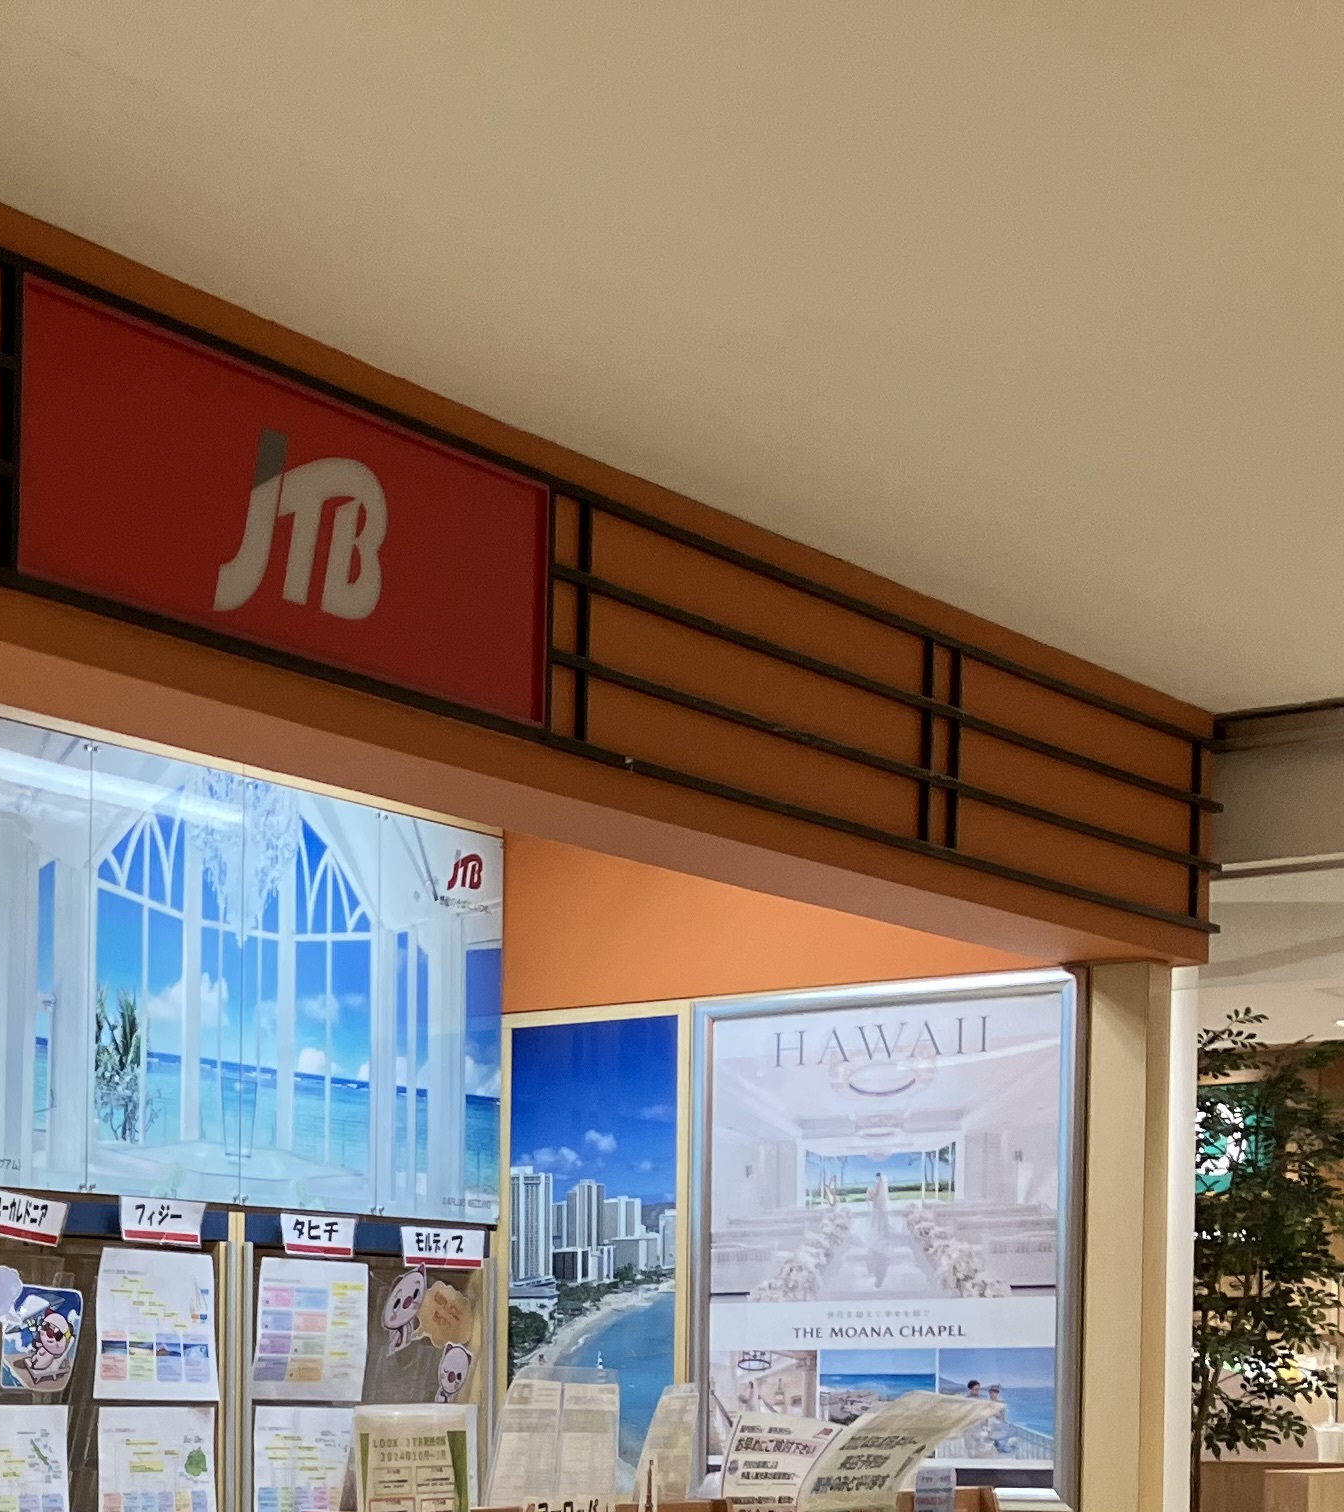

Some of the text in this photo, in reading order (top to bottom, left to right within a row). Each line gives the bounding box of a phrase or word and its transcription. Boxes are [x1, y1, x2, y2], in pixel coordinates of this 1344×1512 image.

[212, 427, 389, 621] JTB
[447, 850, 483, 892] JTB
[772, 1014, 990, 1069] HAWAII
[135, 1204, 182, 1226] フィジー
[293, 1219, 339, 1242] タヒチ
[793, 1323, 967, 1340] THE MOANA CHAPEL
